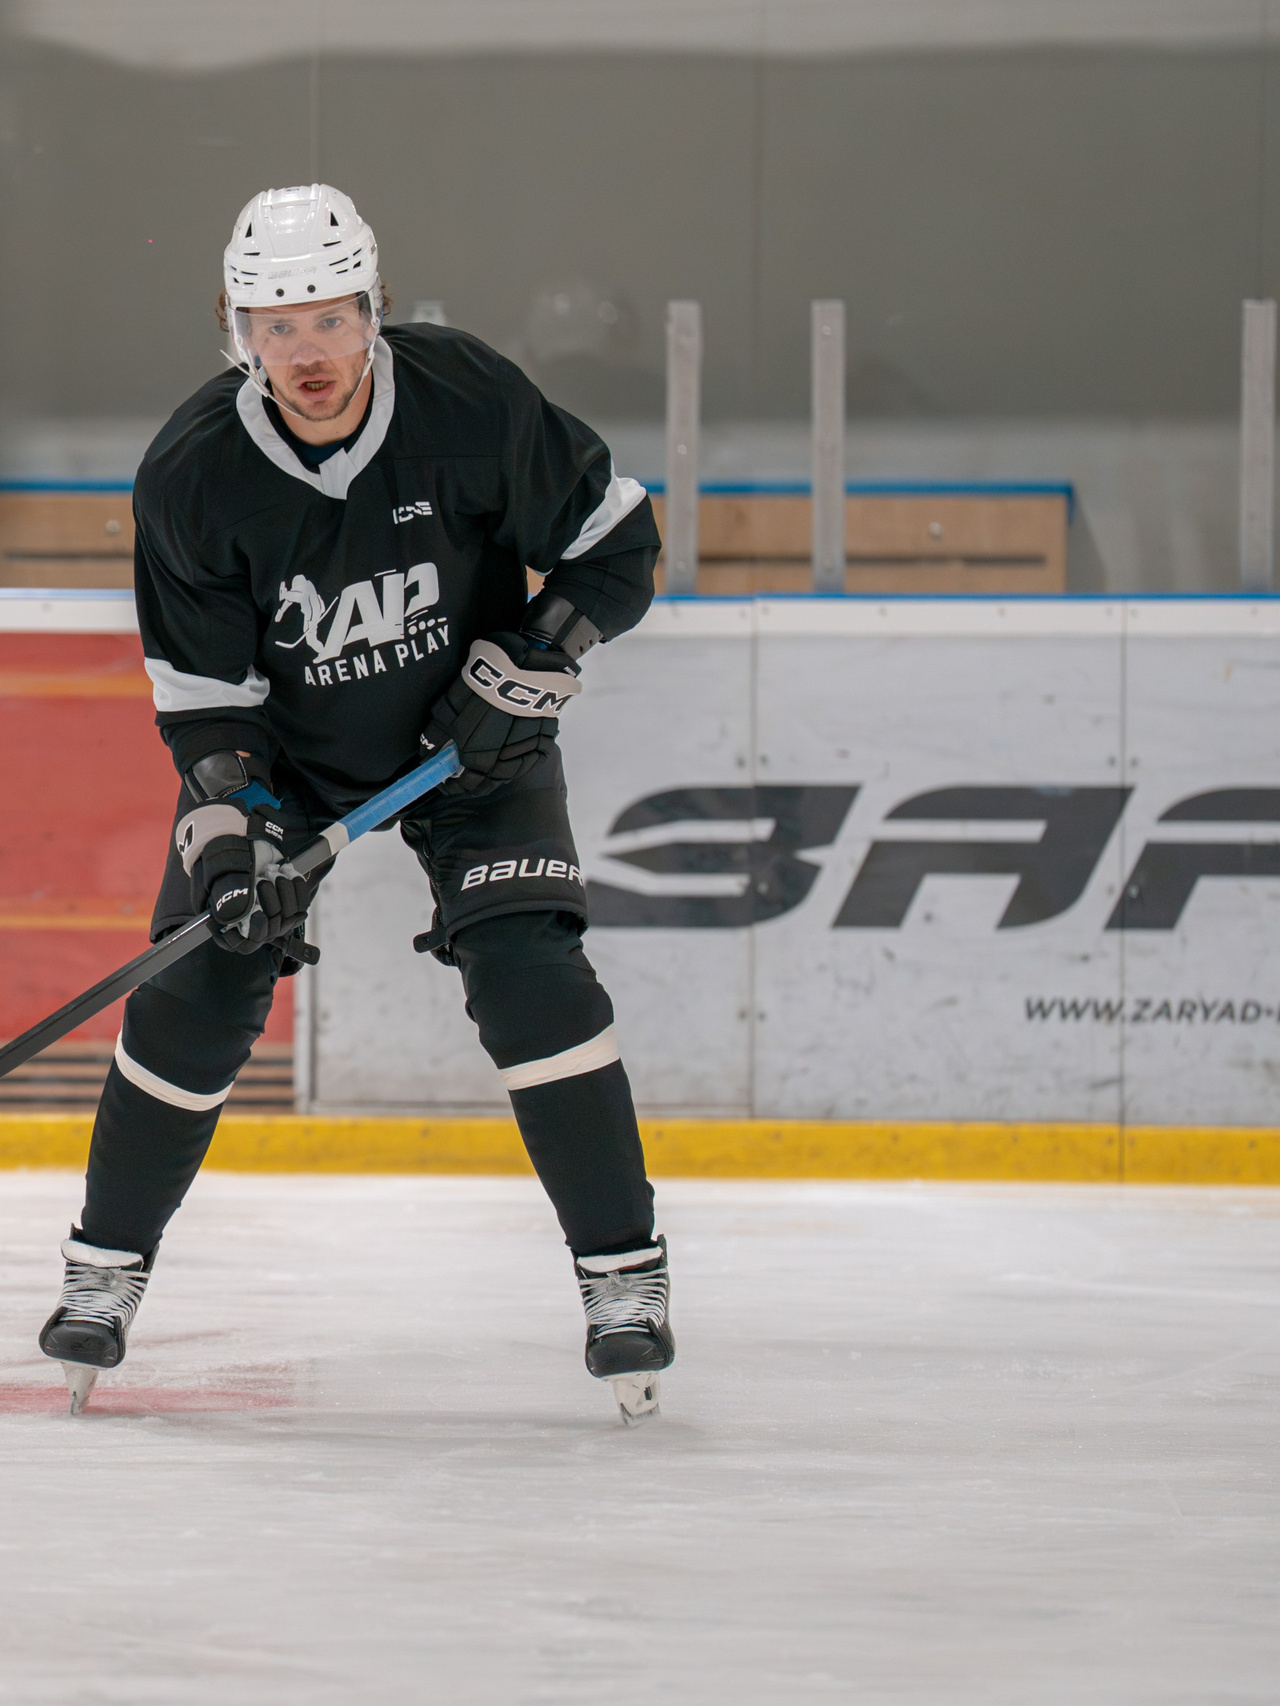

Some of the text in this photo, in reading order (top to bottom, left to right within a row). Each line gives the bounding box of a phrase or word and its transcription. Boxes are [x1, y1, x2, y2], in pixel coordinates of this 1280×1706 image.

[305, 625, 450, 686] ARENA PLAY
[468, 656, 577, 713] CCM
[265, 821, 284, 835] CCM
[216, 888, 249, 912] CCM
[1024, 998, 1280, 1024] WWW.ZARYAD-
